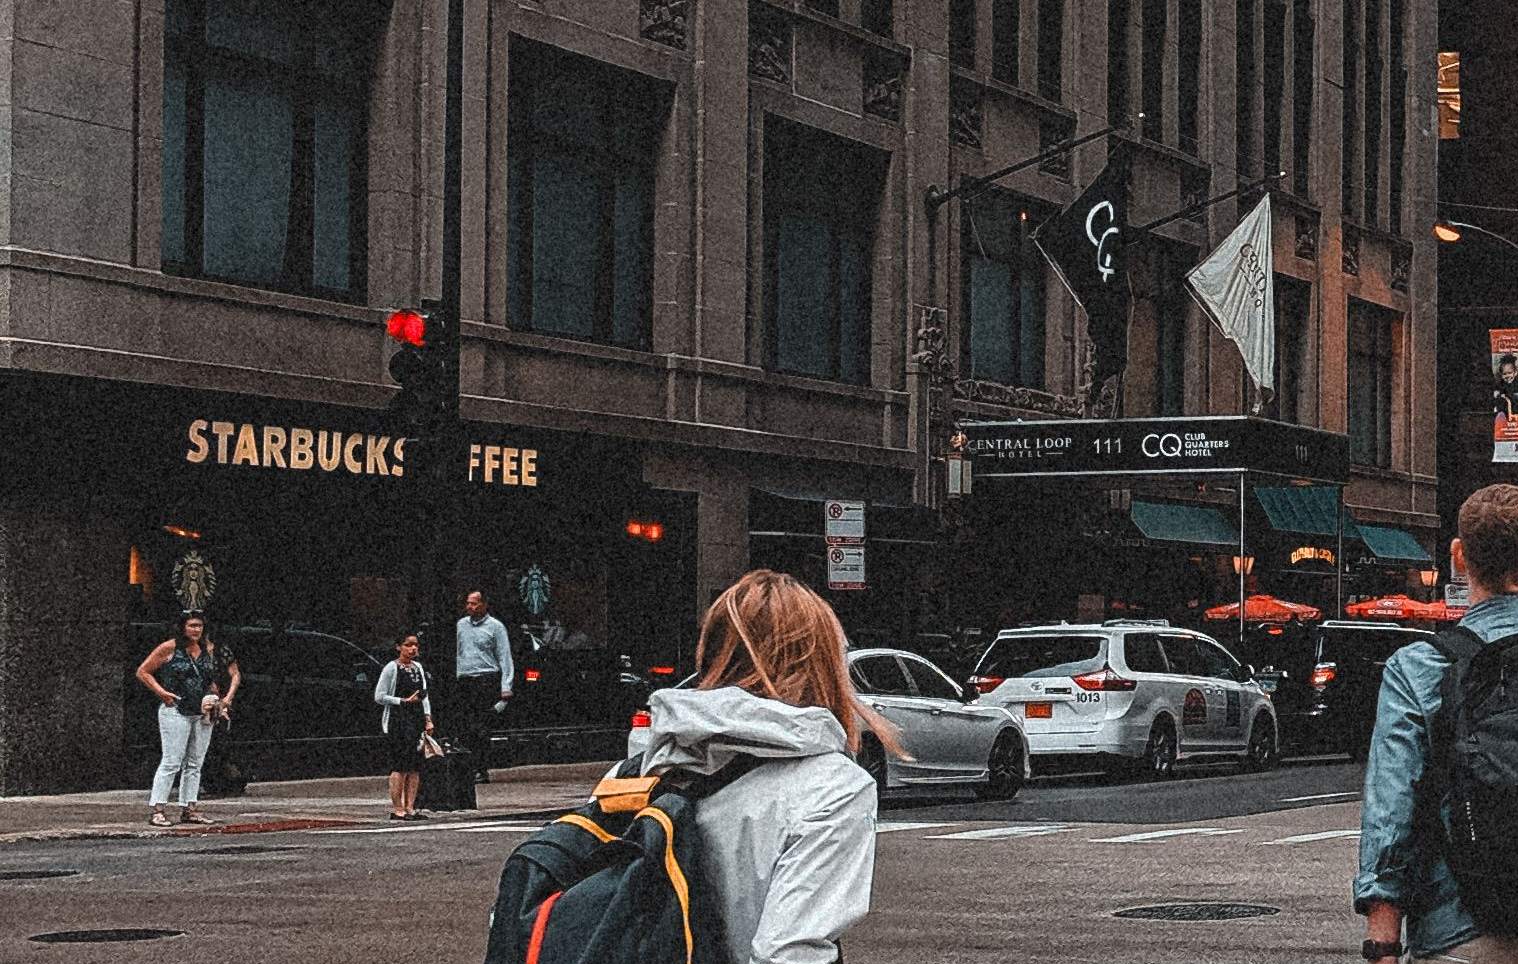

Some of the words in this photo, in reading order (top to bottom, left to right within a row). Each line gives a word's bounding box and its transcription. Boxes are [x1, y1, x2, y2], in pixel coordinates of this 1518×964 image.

[966, 438, 1031, 450] CENTRAL
[1036, 438, 1072, 449] LOOP
[1093, 438, 1122, 454] 111
[1141, 433, 1182, 457] CQ
[1184, 440, 1230, 448] QUARTERS
[186, 419, 404, 477] STARBUCKS
[468, 444, 538, 487] FFEE
[998, 450, 1042, 458] HOTEL
[1076, 692, 1100, 703] 1013
